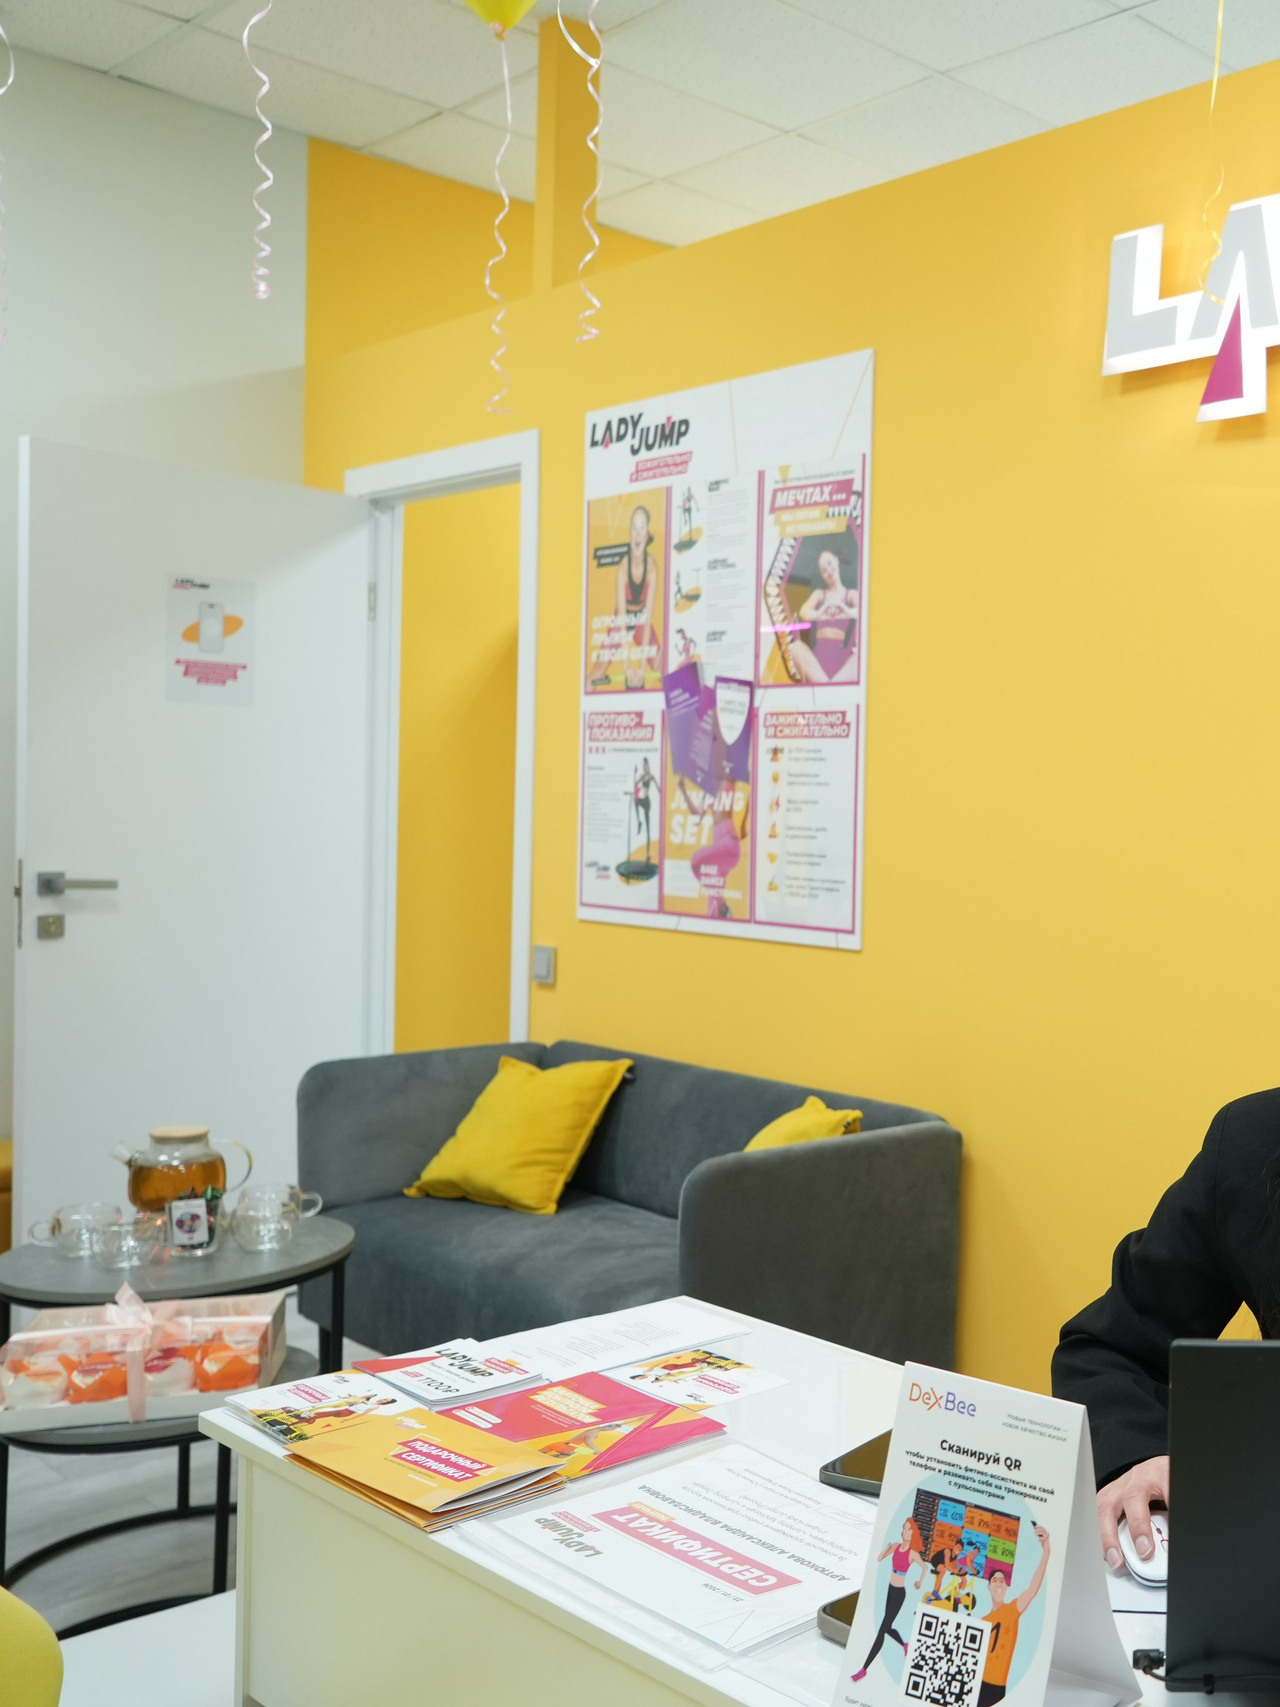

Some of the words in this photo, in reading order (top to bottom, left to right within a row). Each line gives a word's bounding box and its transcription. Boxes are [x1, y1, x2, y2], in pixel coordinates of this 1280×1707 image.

[590, 413, 643, 448] LADY
[630, 416, 689, 456] JUMP
[589, 713, 640, 727] ПРОТИВО-
[591, 726, 653, 741] ПОКАЗАНИЯ
[765, 713, 843, 726] ЗАЖИГАТЕЛЬНО
[766, 727, 775, 737] И
[776, 725, 848, 738] СЖИГАТЕЛЬНО
[671, 790, 745, 812] JUMPING
[670, 815, 715, 845] SET
[448, 1362, 494, 1377] JUMP
[401, 1452, 473, 1479] СЕРТИФИКАТ
[407, 1441, 487, 1470] ПОДАРОЧНЫЙ
[940, 1439, 1001, 1465] Сканируй
[1004, 1456, 1022, 1471] QR
[905, 1449, 925, 1460] чтобы
[926, 1454, 962, 1470] установить
[963, 1465, 1028, 1489] фитнес-ассистента
[1028, 1483, 1038, 1491] на
[1038, 1484, 1055, 1496] свой
[909, 1460, 937, 1473] телефон
[943, 1469, 977, 1484] развивать
[977, 1477, 994, 1488] себя
[994, 1483, 1003, 1491] на
[1003, 1484, 1048, 1504] тренировках
[638, 1484, 722, 1526] ВЛАДИСЛАВОВНА
[953, 1481, 1006, 1501] пульсометрами
[534, 1518, 585, 1539] JUMP
[720, 1523, 789, 1555] АЛЕКСАНДРА
[553, 1537, 603, 1557] LADY
[611, 1513, 778, 1586] СЕРТИФИКАТ
[787, 1553, 850, 1581] АРТЮКОВА
